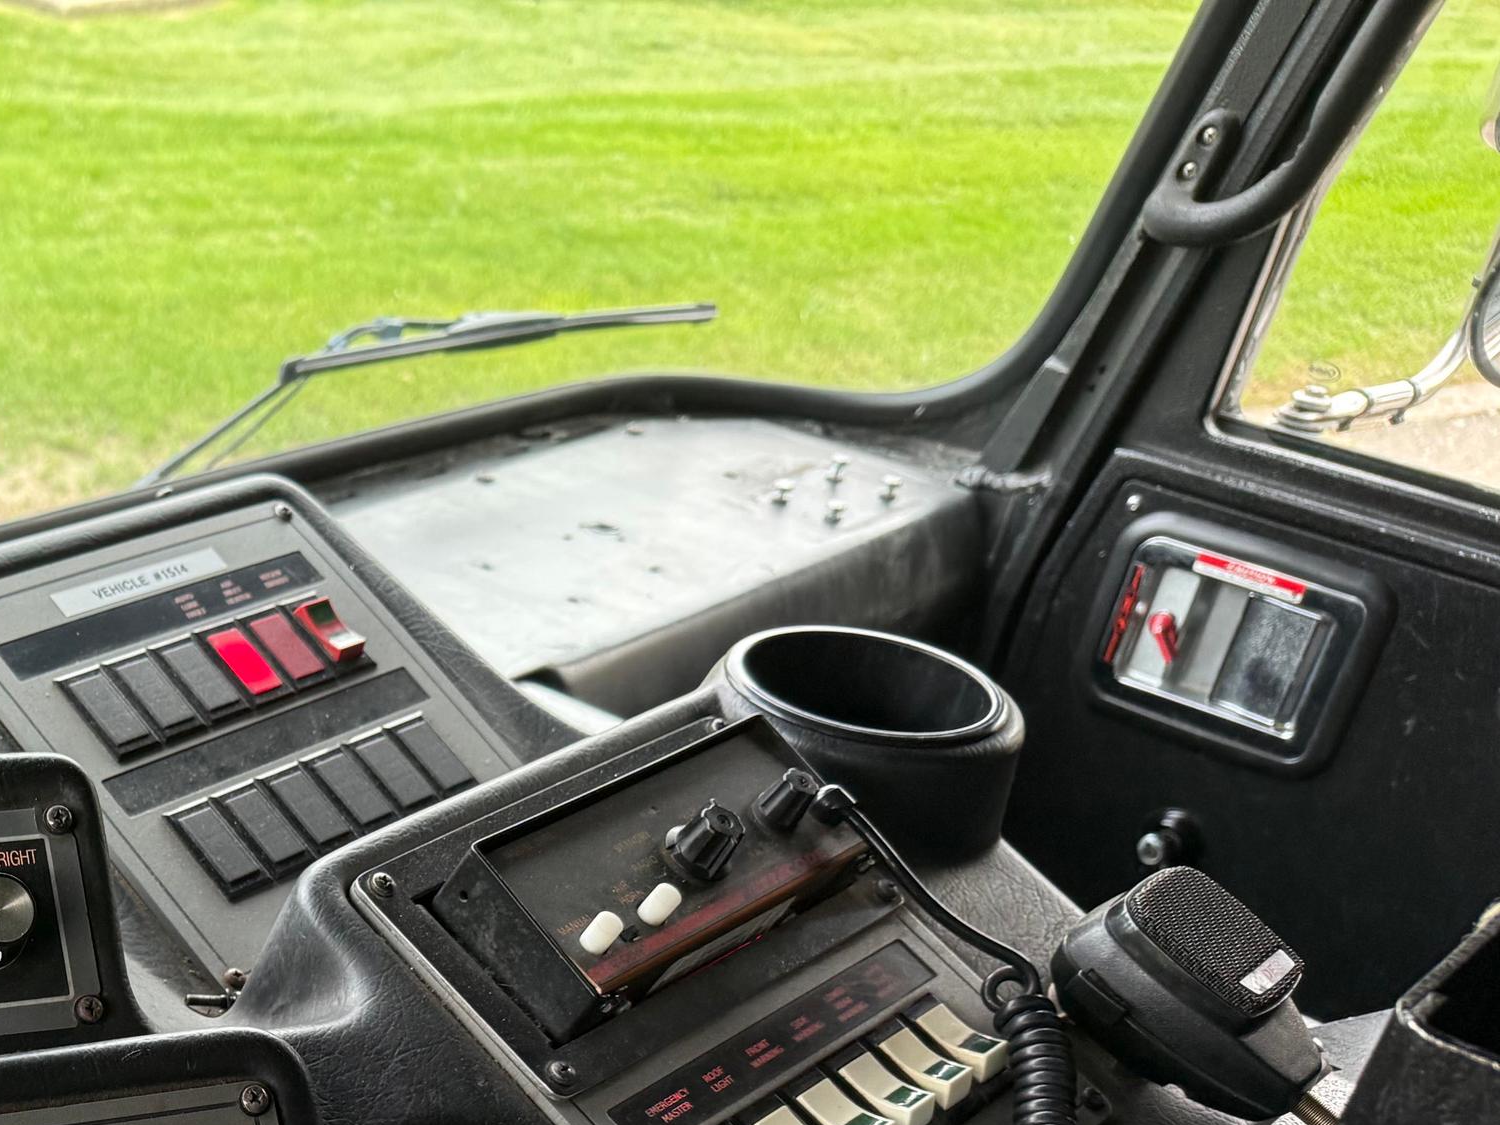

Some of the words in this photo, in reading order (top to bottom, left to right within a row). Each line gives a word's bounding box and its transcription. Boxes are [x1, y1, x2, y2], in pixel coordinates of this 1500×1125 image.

[92, 575, 150, 599] VEHICLE
[702, 1065, 725, 1084] ROOF
[710, 1074, 735, 1093] LIGHT
[644, 1087, 690, 1118] EMERGENCY
[660, 1101, 695, 1124] MASTER
